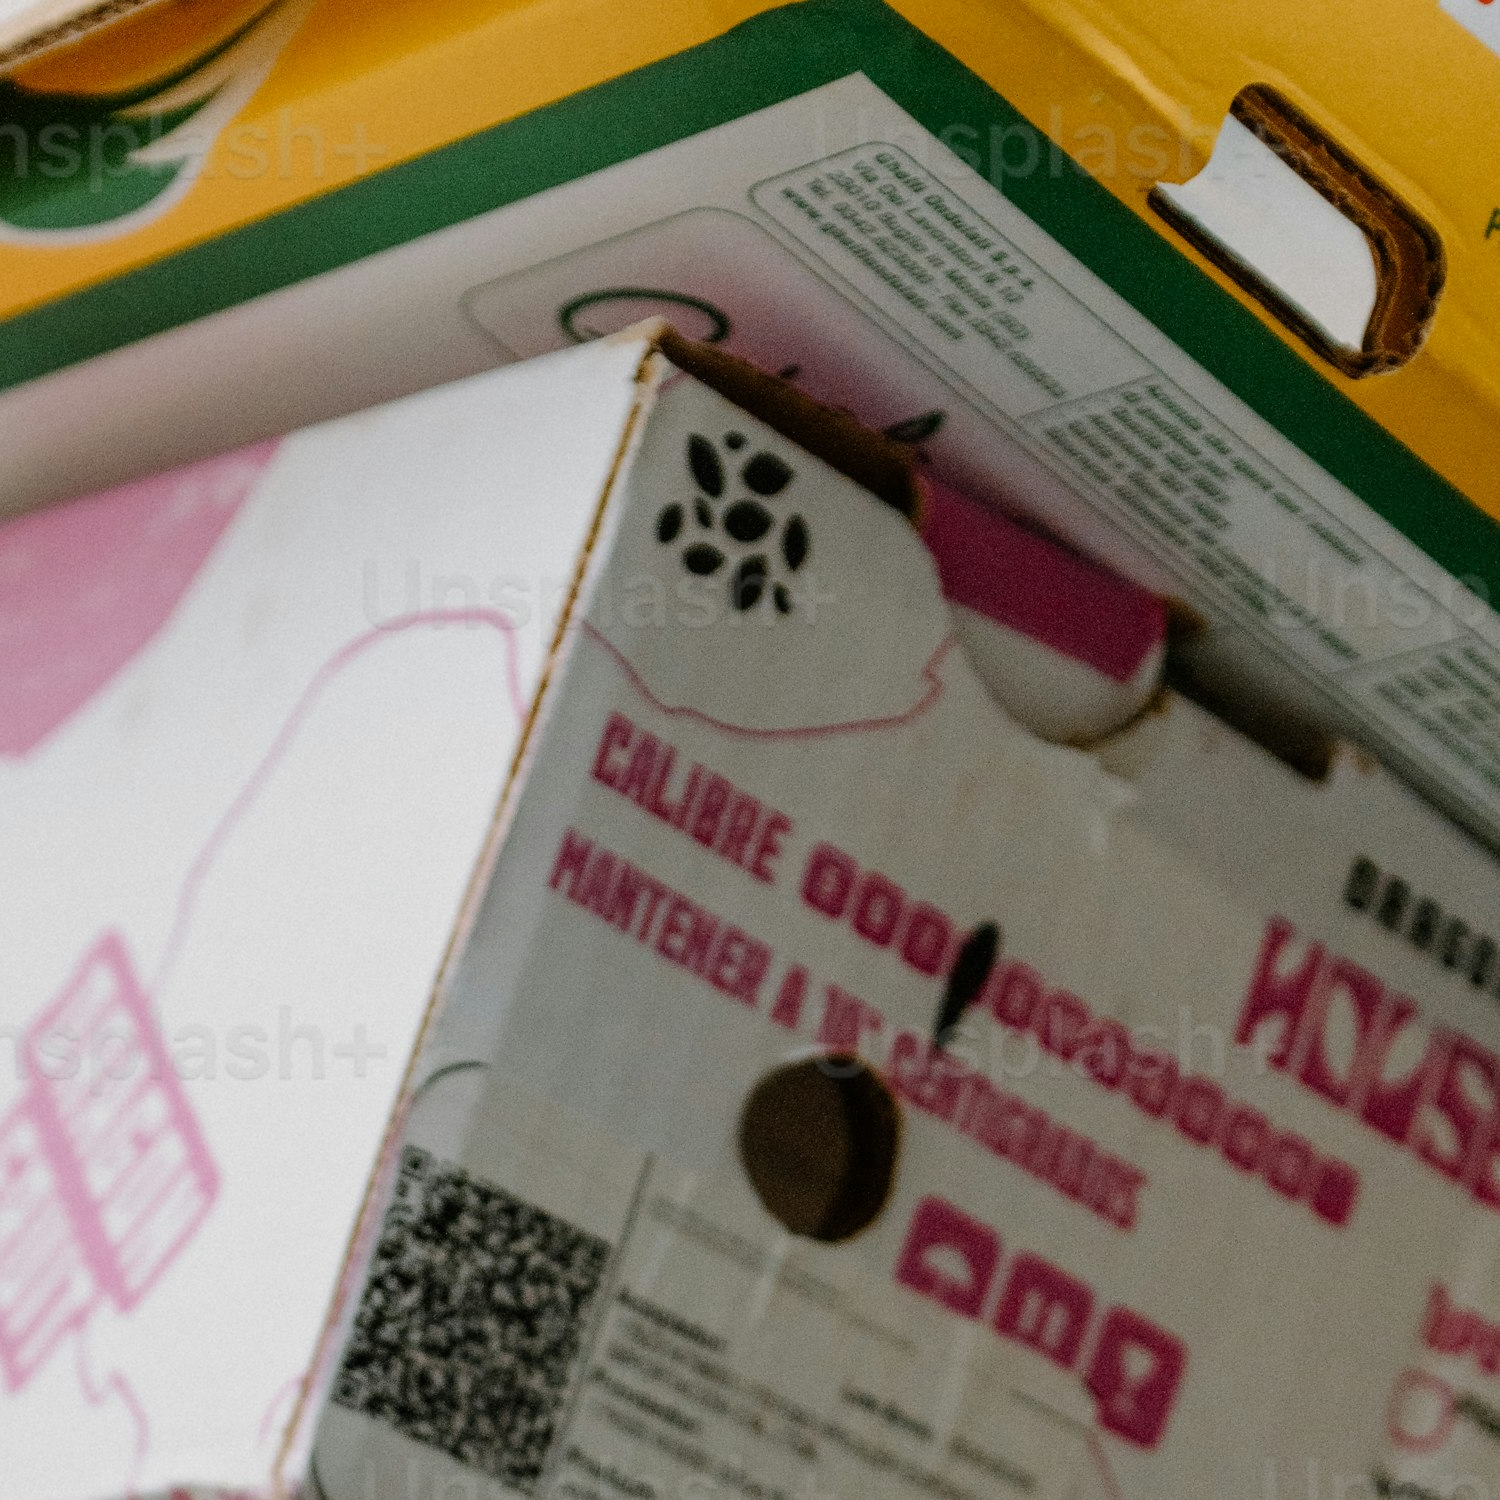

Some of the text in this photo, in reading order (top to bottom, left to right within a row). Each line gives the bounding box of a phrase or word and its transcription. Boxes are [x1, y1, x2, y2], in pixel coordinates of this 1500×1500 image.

[854, 164, 879, 185] Via
[590, 712, 797, 885] CALIBRE
[549, 829, 775, 1008] MANTENER
